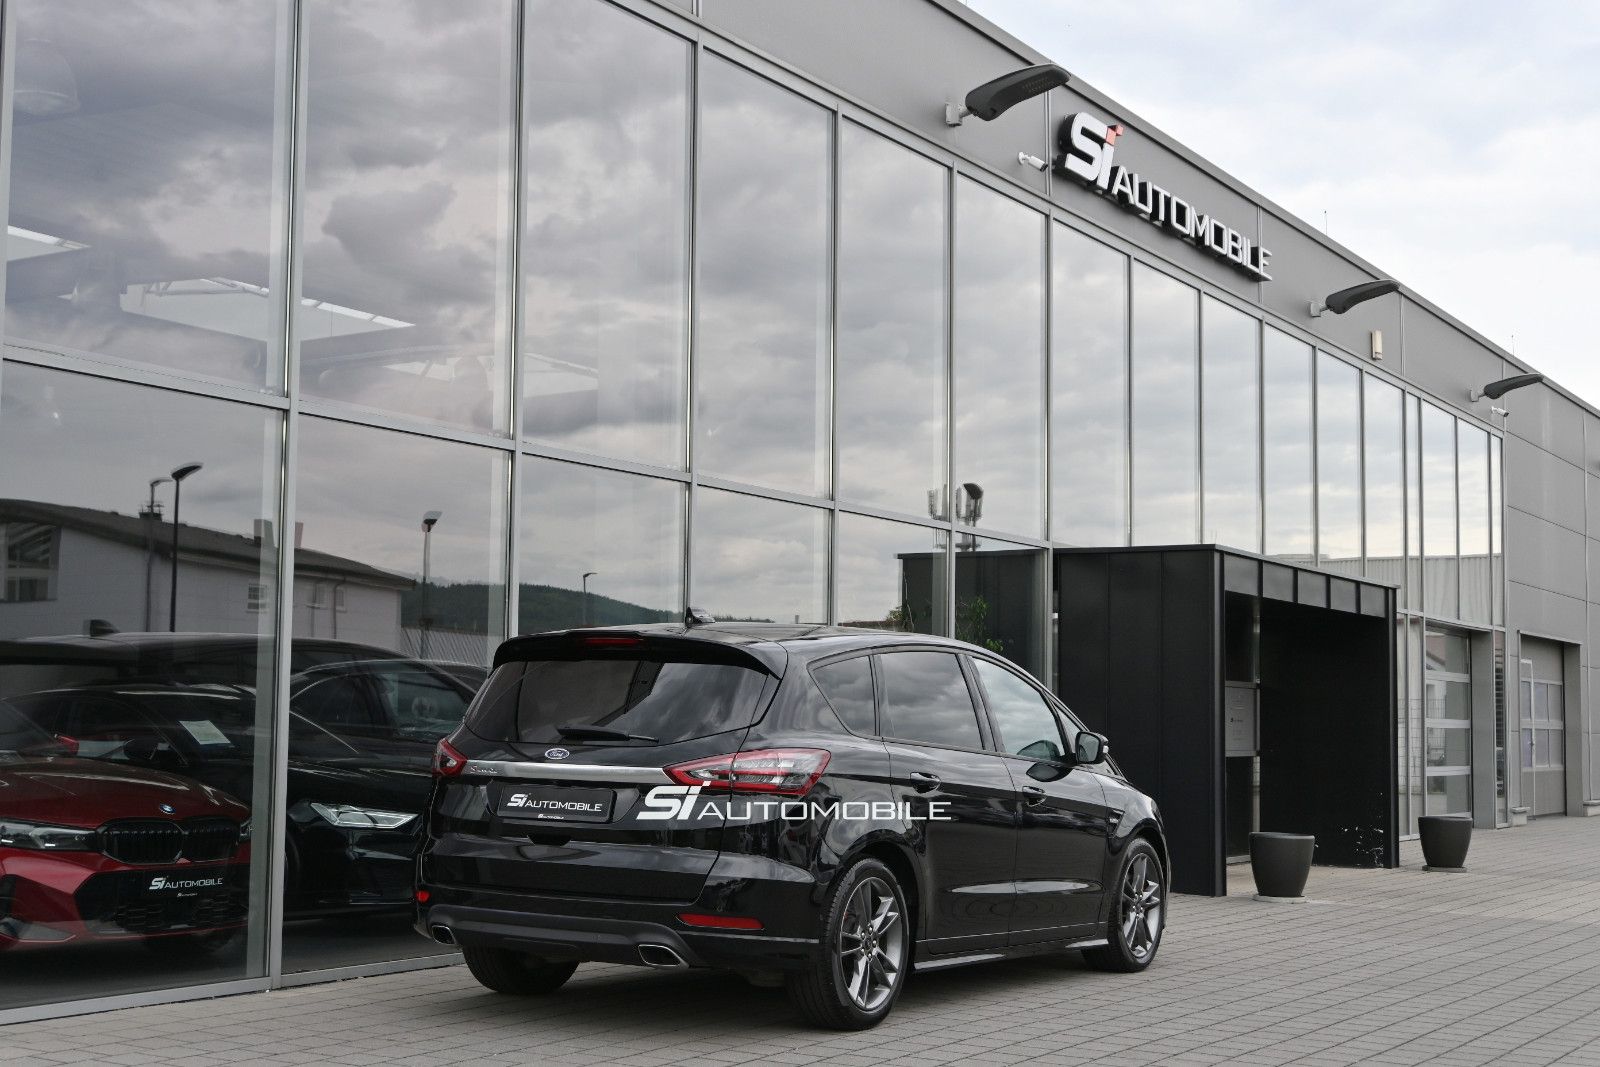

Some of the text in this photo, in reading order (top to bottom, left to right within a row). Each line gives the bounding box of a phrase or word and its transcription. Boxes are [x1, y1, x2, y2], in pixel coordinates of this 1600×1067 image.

[1111, 165, 1273, 281] AUTOMOBILE
[526, 799, 603, 812] AUTOMOBILE
[164, 878, 223, 889] AUTOMOBILE
